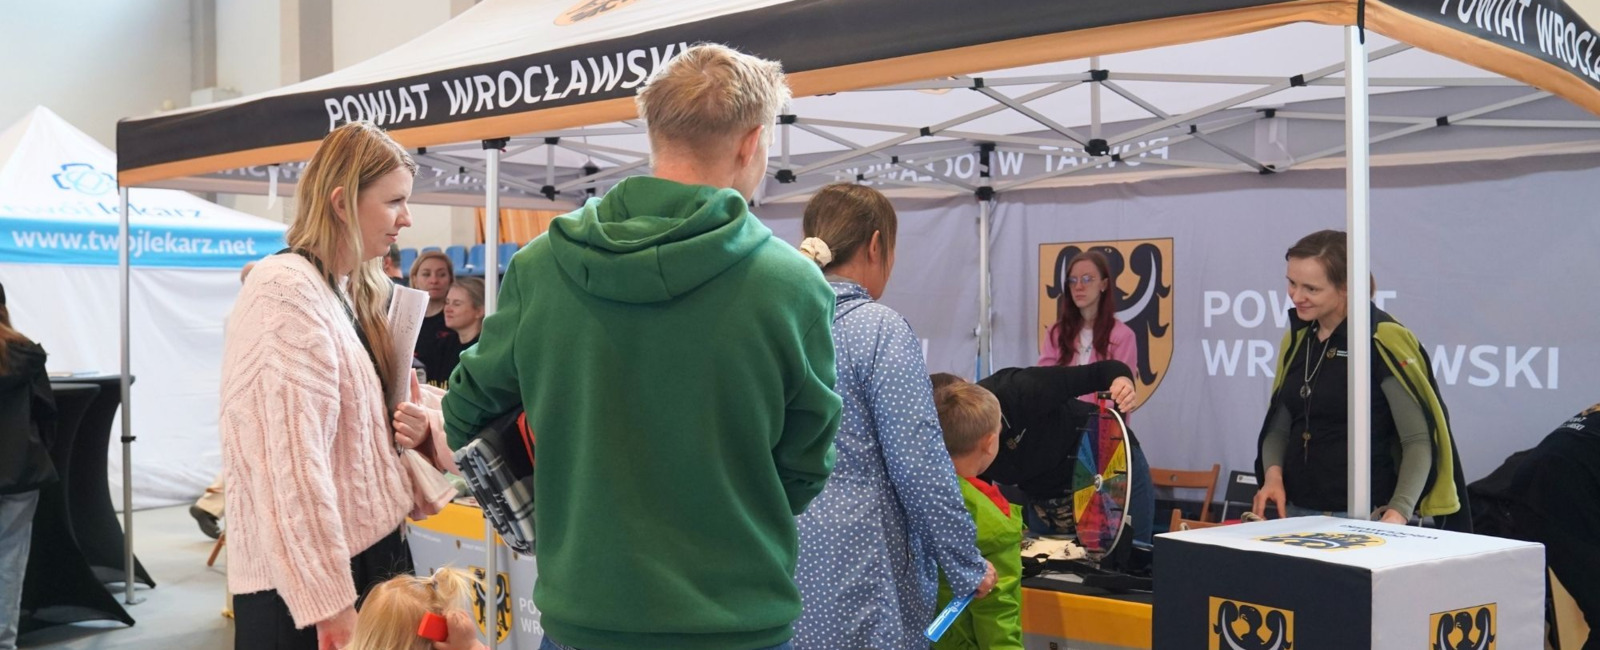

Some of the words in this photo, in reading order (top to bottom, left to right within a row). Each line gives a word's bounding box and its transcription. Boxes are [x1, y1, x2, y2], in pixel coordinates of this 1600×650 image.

[324, 83, 430, 132] POWIAT
[442, 42, 688, 116] WROCŁAWSK
[12, 229, 257, 258] www.twojlekarz.net
[1204, 290, 1397, 328] POWT
[1201, 339, 1559, 389] WRWSKI
